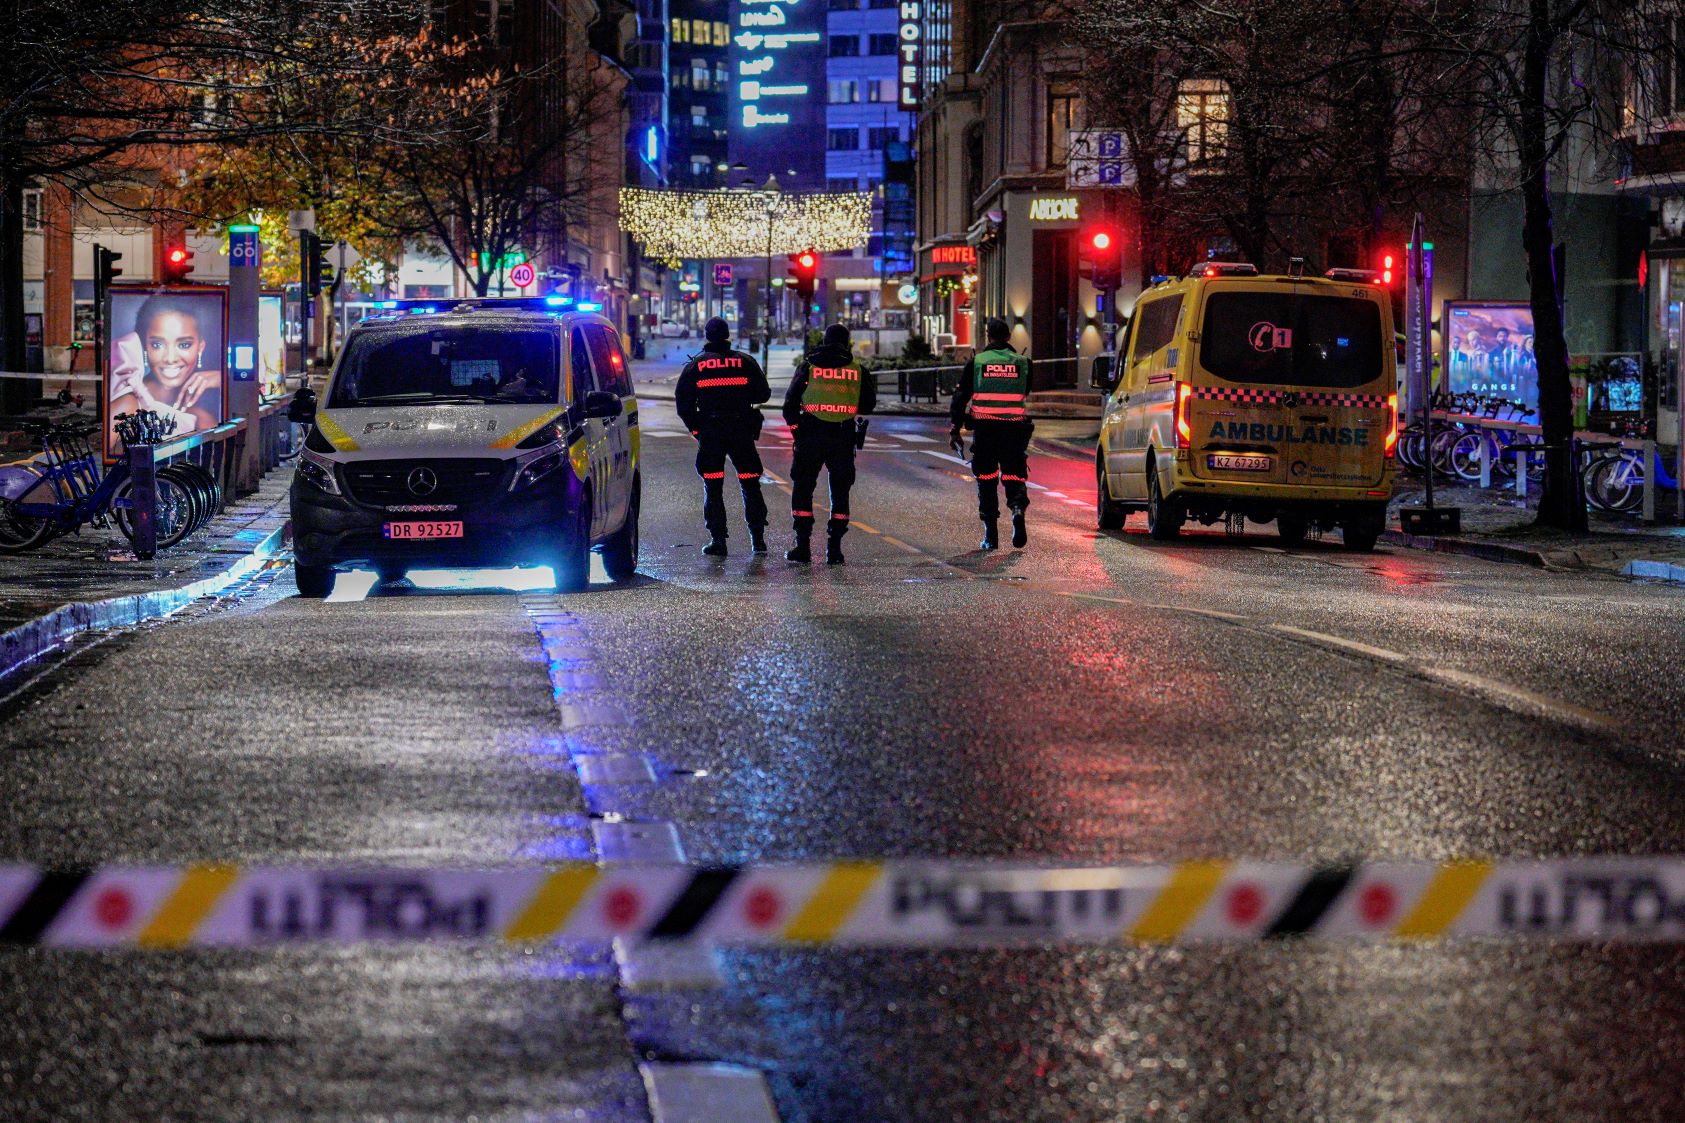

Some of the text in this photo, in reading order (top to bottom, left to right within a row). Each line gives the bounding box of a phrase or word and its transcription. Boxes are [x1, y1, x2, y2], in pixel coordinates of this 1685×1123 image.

[900, 1, 919, 105] HOTEL
[941, 246, 977, 265] HOTEL
[514, 269, 530, 281] 40
[1351, 288, 1368, 298] 461
[1277, 331, 1287, 346] 1
[698, 357, 742, 372] POLITI
[986, 364, 1016, 373] POLITI
[812, 367, 858, 381] POLITI
[1471, 383, 1517, 392] GANGS
[820, 404, 847, 413] POLITI
[1209, 420, 1370, 446] AMBULANSE
[1216, 456, 1267, 469] KZ 67295
[393, 523, 460, 537] DR 92527
